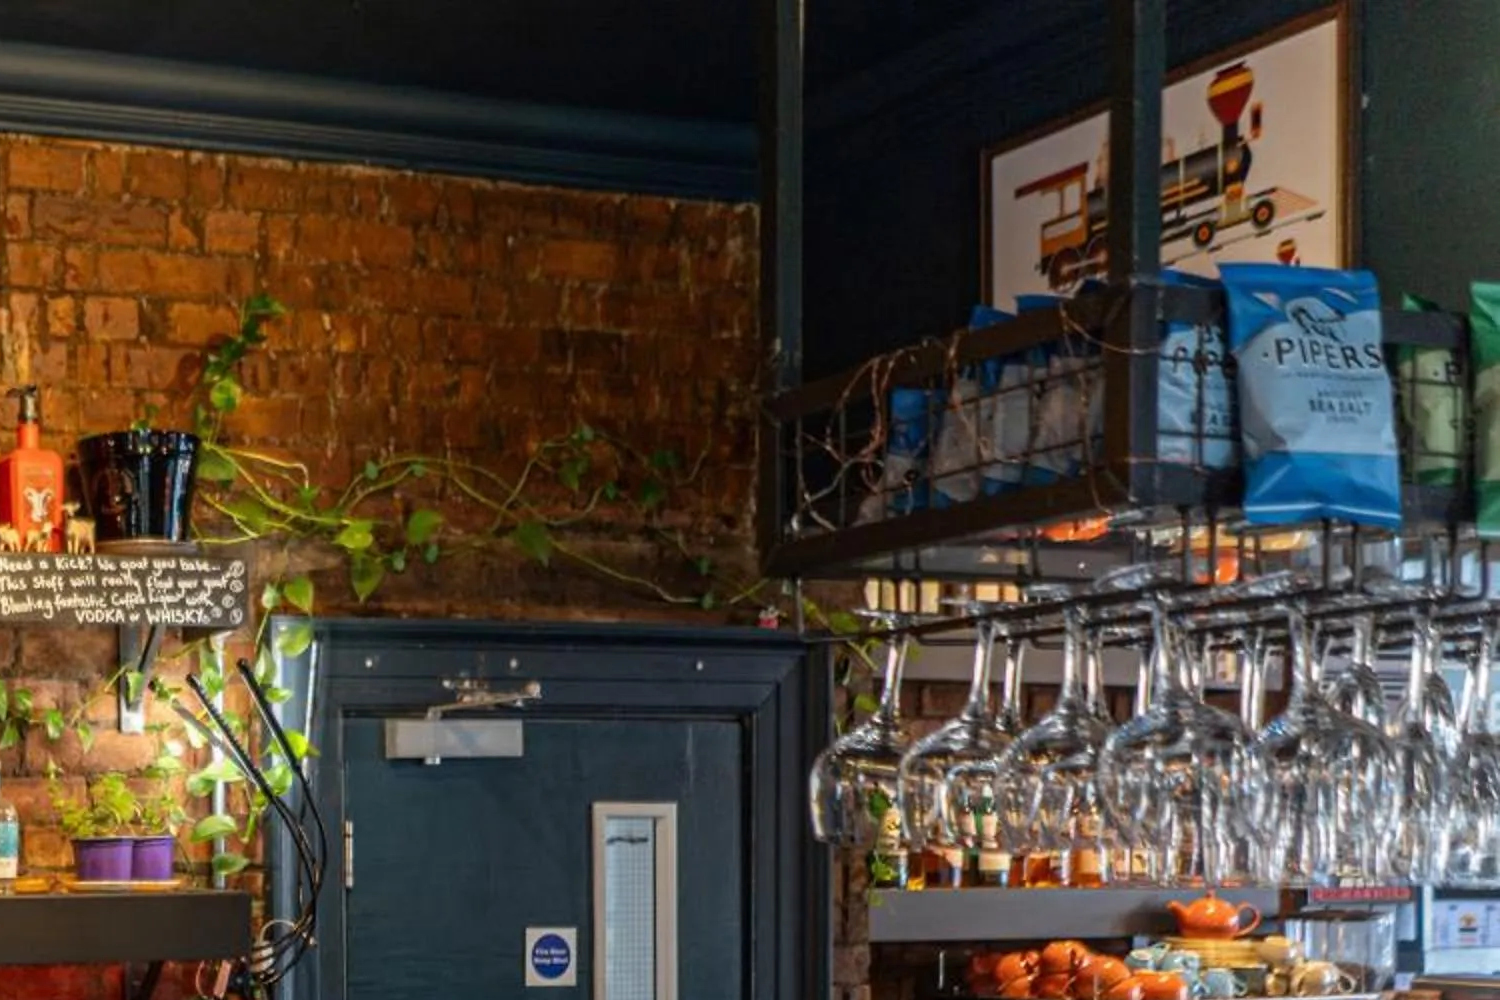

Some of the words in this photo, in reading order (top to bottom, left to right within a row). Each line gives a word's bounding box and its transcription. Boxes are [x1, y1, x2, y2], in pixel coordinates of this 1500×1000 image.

[1273, 336, 1383, 370] PIPERS
[1308, 398, 1336, 413] SEA
[39, 559, 50, 570] a
[75, 610, 125, 624] VODKA
[146, 609, 204, 625] WHISKY
